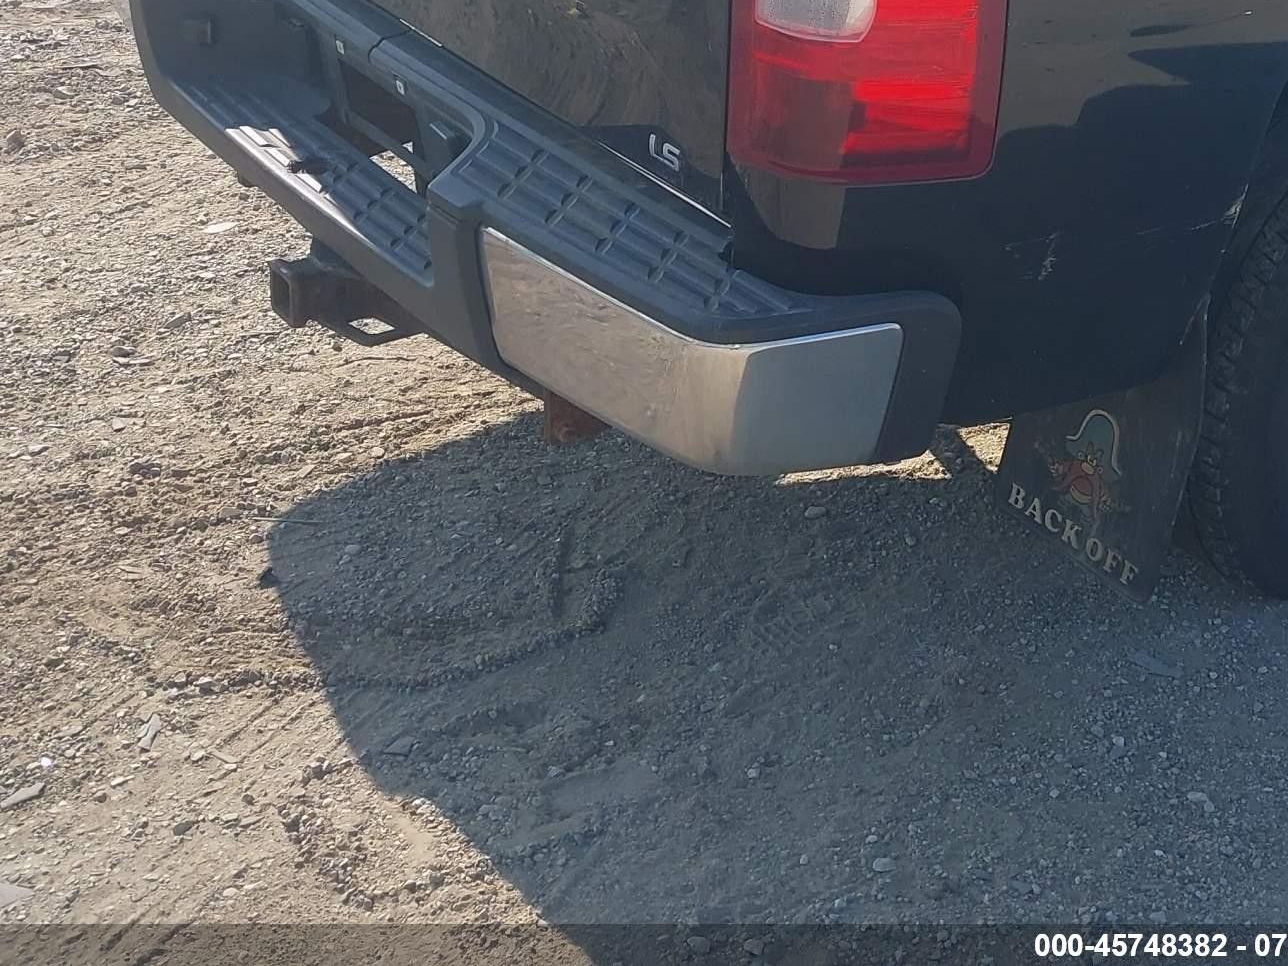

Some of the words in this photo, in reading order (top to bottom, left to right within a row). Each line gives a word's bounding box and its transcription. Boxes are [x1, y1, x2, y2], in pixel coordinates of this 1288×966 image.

[649, 133, 681, 172] LS
[1008, 483, 1082, 549] BACK
[1086, 537, 1139, 585] OFF
